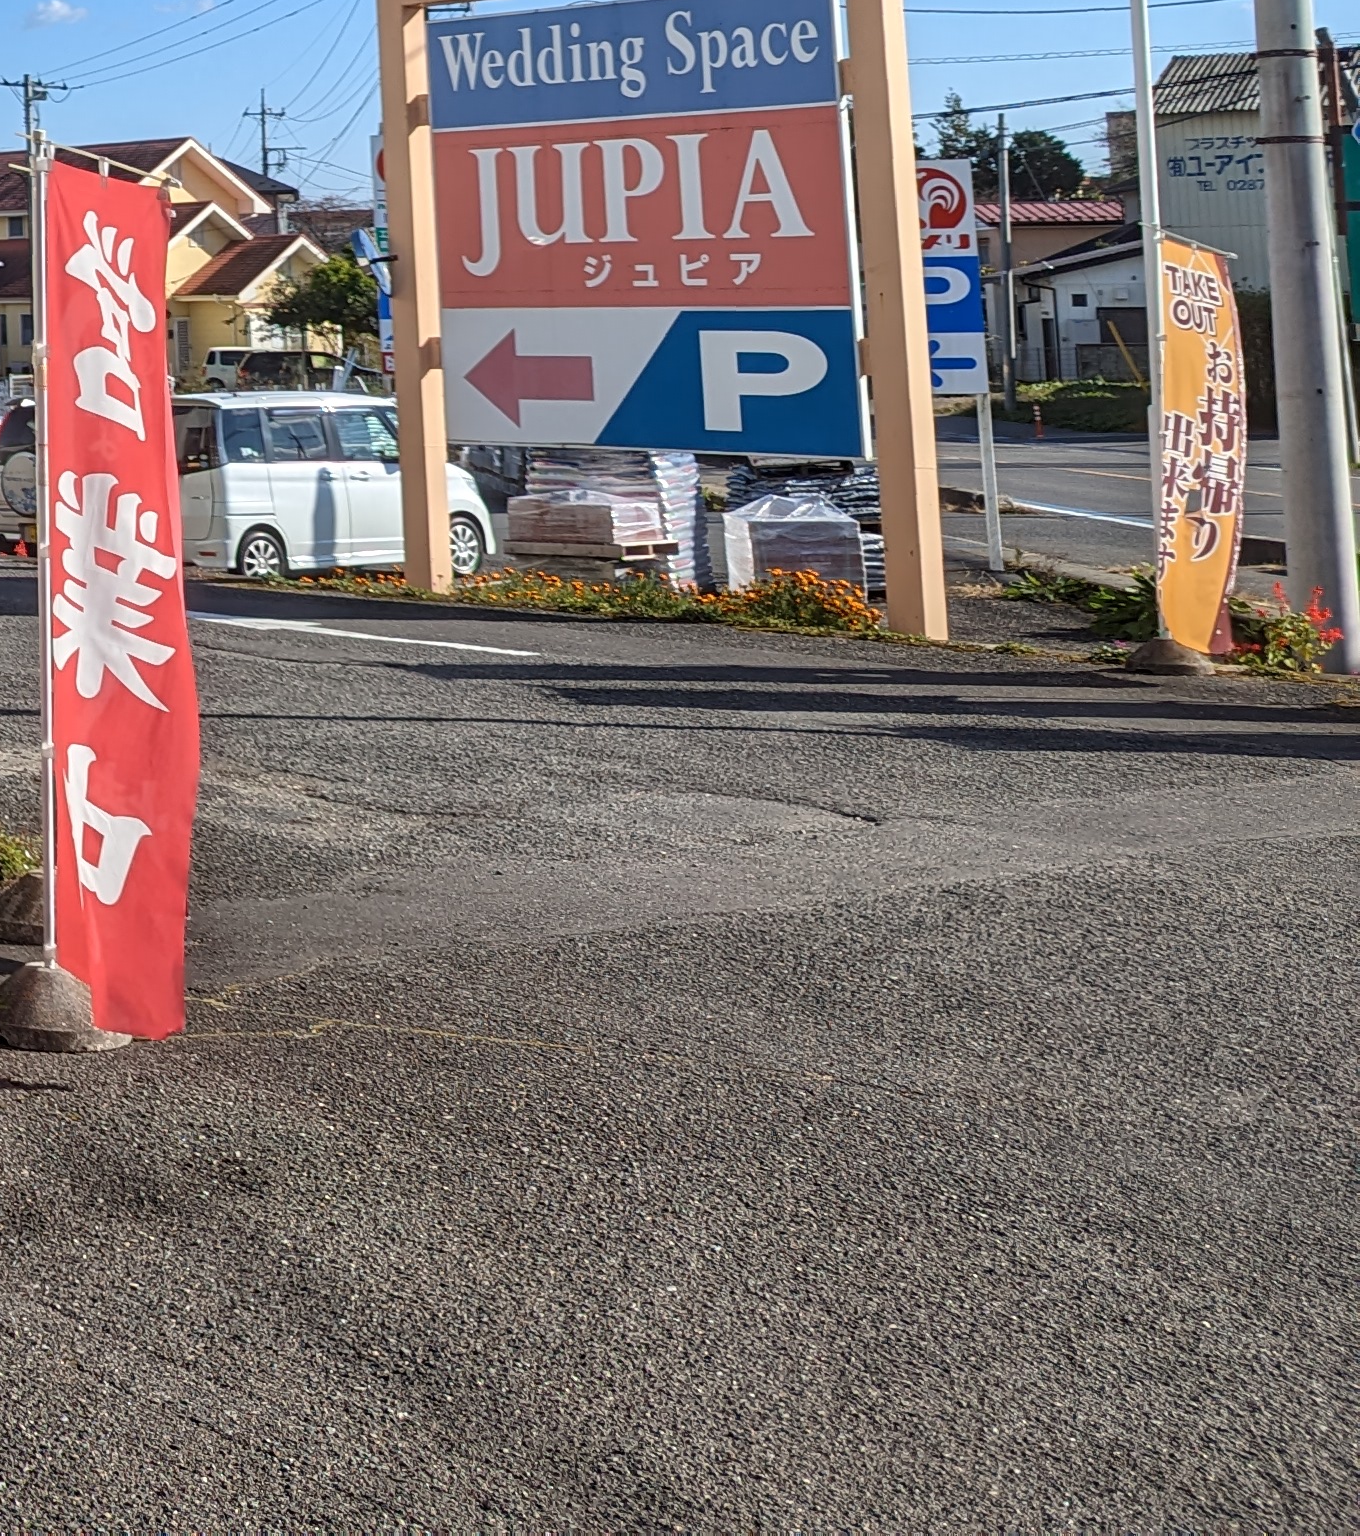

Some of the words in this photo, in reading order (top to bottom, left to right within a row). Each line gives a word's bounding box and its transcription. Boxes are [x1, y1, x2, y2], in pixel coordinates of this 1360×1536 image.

[438, 21, 646, 99] Wedding
[664, 9, 820, 94] Space
[1185, 135, 1261, 151] プラスチッ
[460, 128, 816, 278] JUPIA
[1196, 180, 1217, 192] TEL
[582, 251, 763, 289] ジュピア
[1164, 263, 1223, 308] TAKE
[1170, 297, 1219, 337] OUT
[697, 329, 829, 432] P
[1191, 341, 1241, 563] お持帰り
